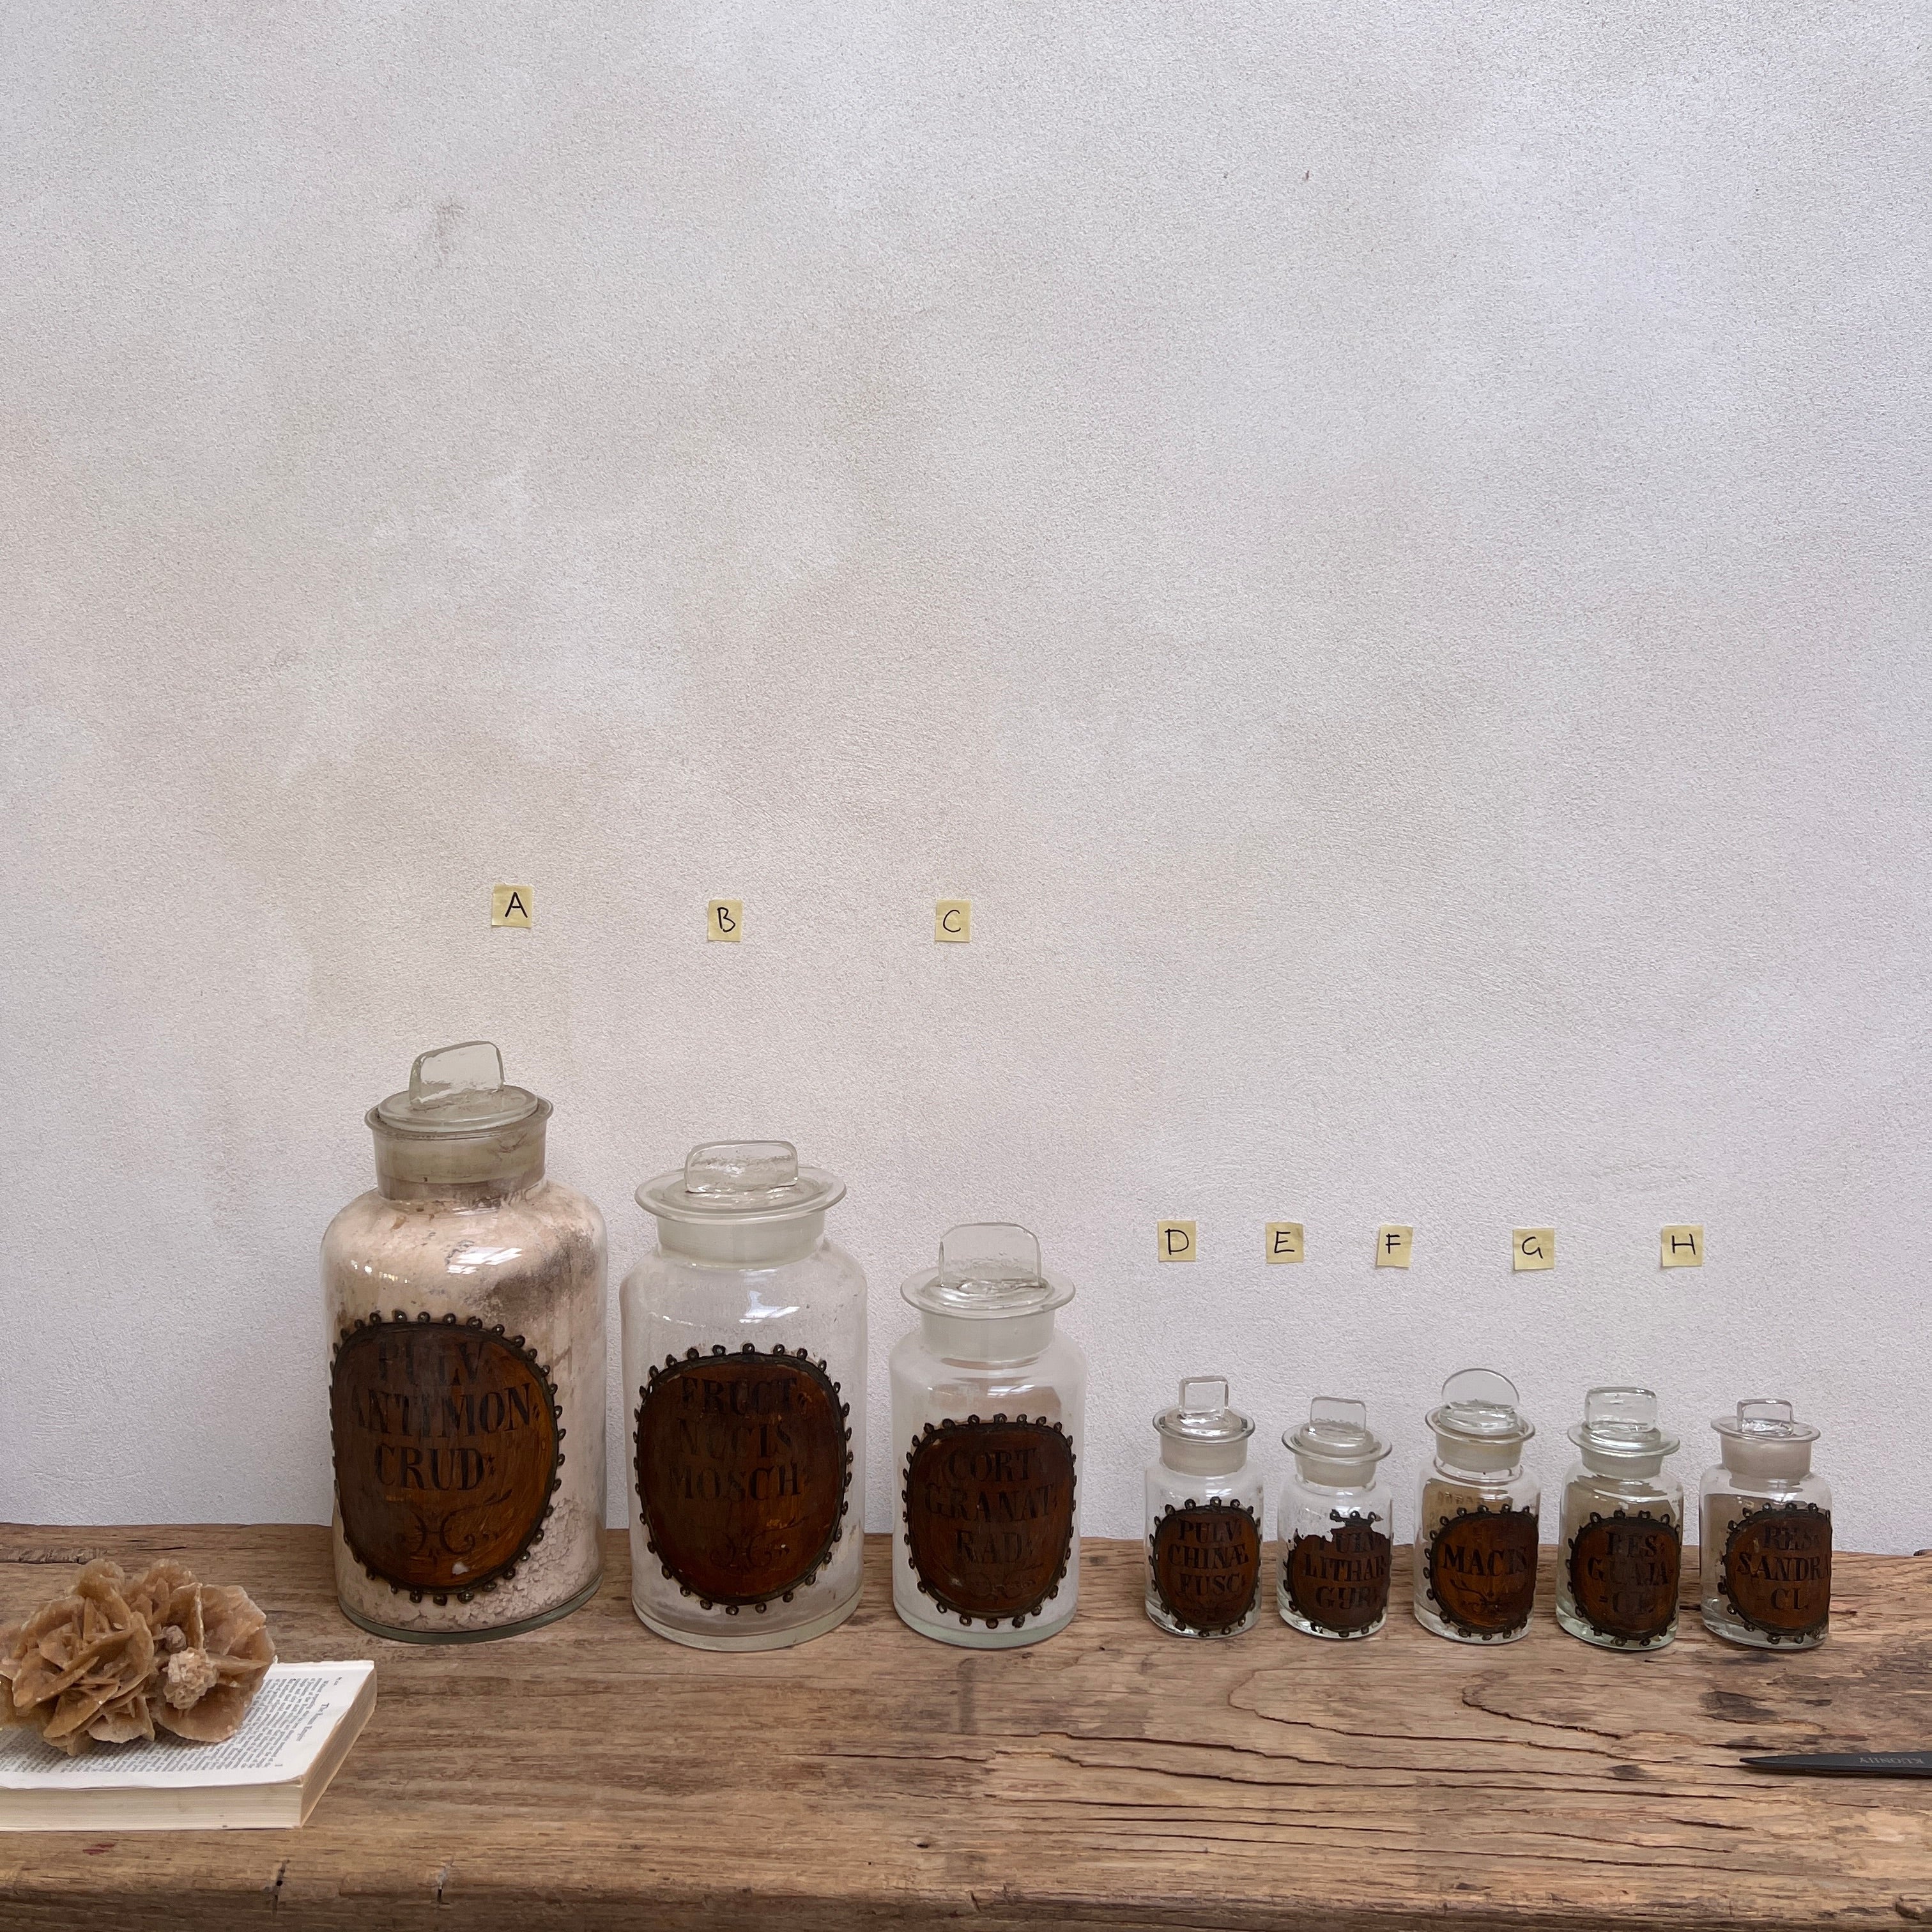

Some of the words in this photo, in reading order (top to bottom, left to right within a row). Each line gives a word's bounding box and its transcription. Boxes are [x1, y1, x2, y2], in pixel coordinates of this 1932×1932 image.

[505, 891, 528, 918] A
[717, 907, 736, 933] B
[942, 909, 962, 933] C
[1164, 1228, 1190, 1255] D
[1274, 1230, 1295, 1254] E
[1385, 1233, 1401, 1254] F
[1521, 1236, 1543, 1259] G
[1671, 1234, 1696, 1255] H
